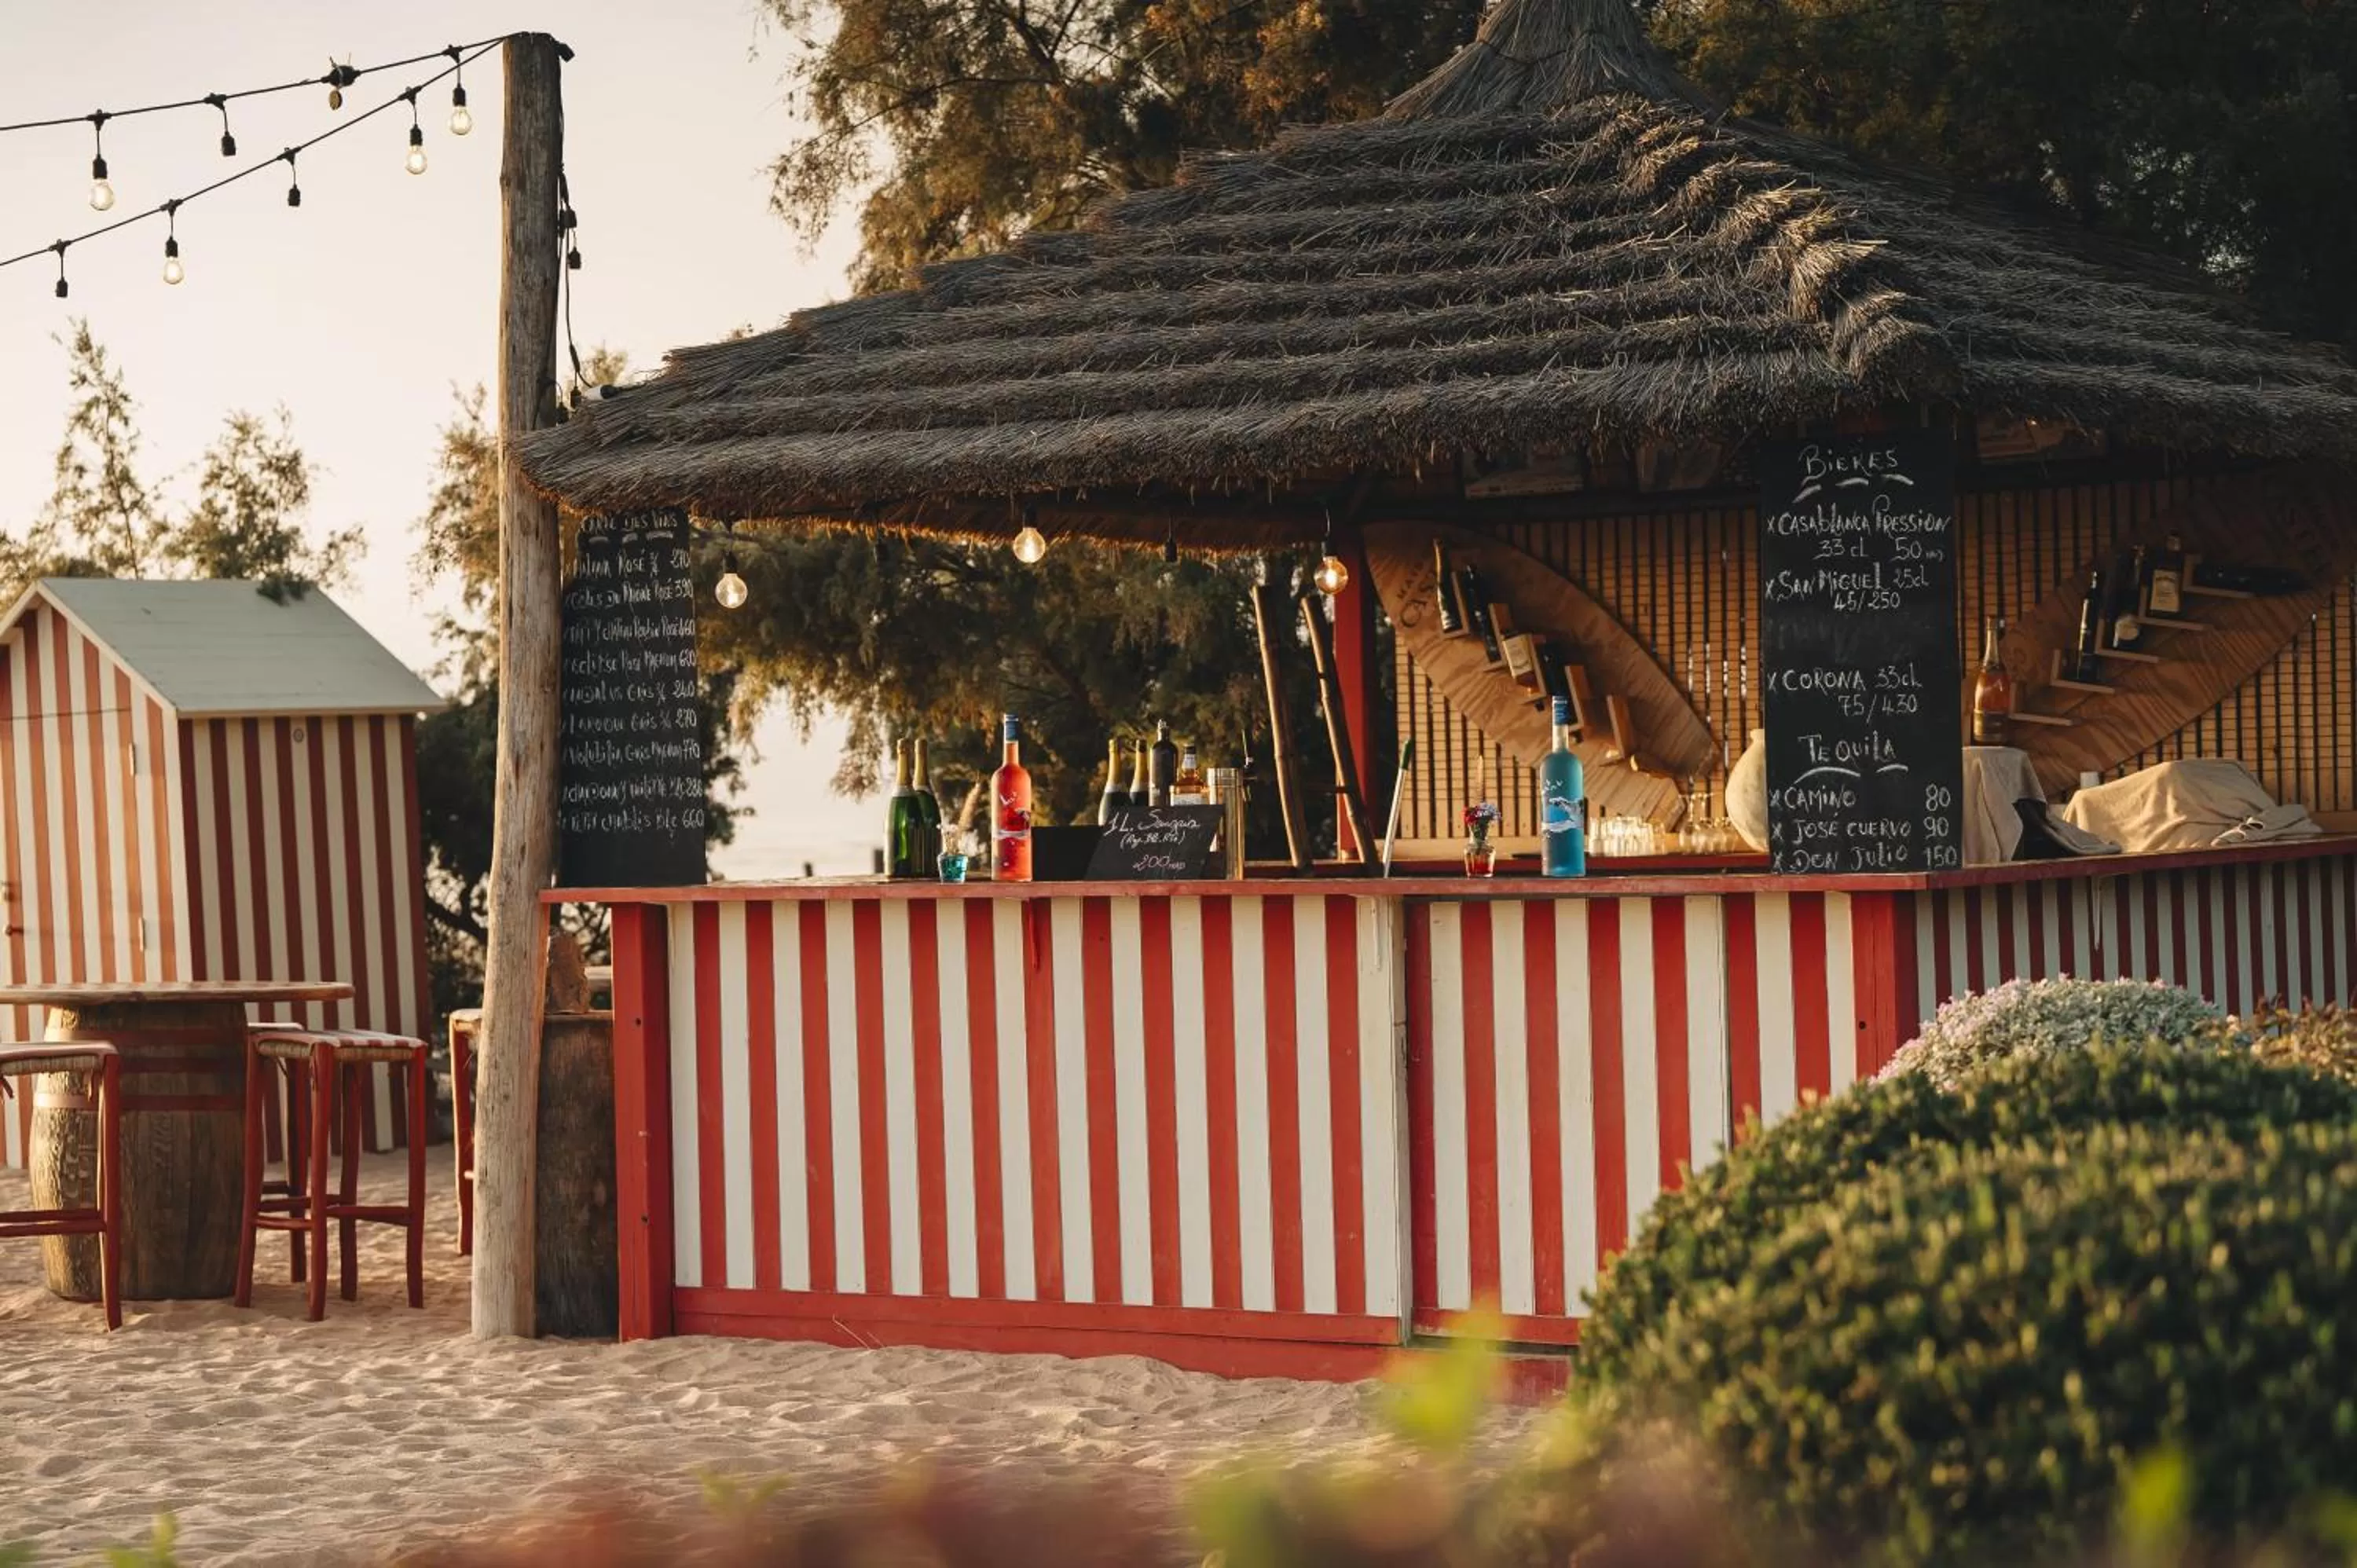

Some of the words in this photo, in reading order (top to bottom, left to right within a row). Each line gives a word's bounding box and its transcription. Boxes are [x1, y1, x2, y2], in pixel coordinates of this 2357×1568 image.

[1812, 539, 1845, 560] 33
[1782, 668, 1866, 696] CORONA
[1926, 784, 1951, 811] 80
[1847, 819, 1912, 839] CUERVO
[1924, 816, 1948, 839] 90
[1790, 849, 1838, 873] DON
[1924, 846, 1957, 868] 150
